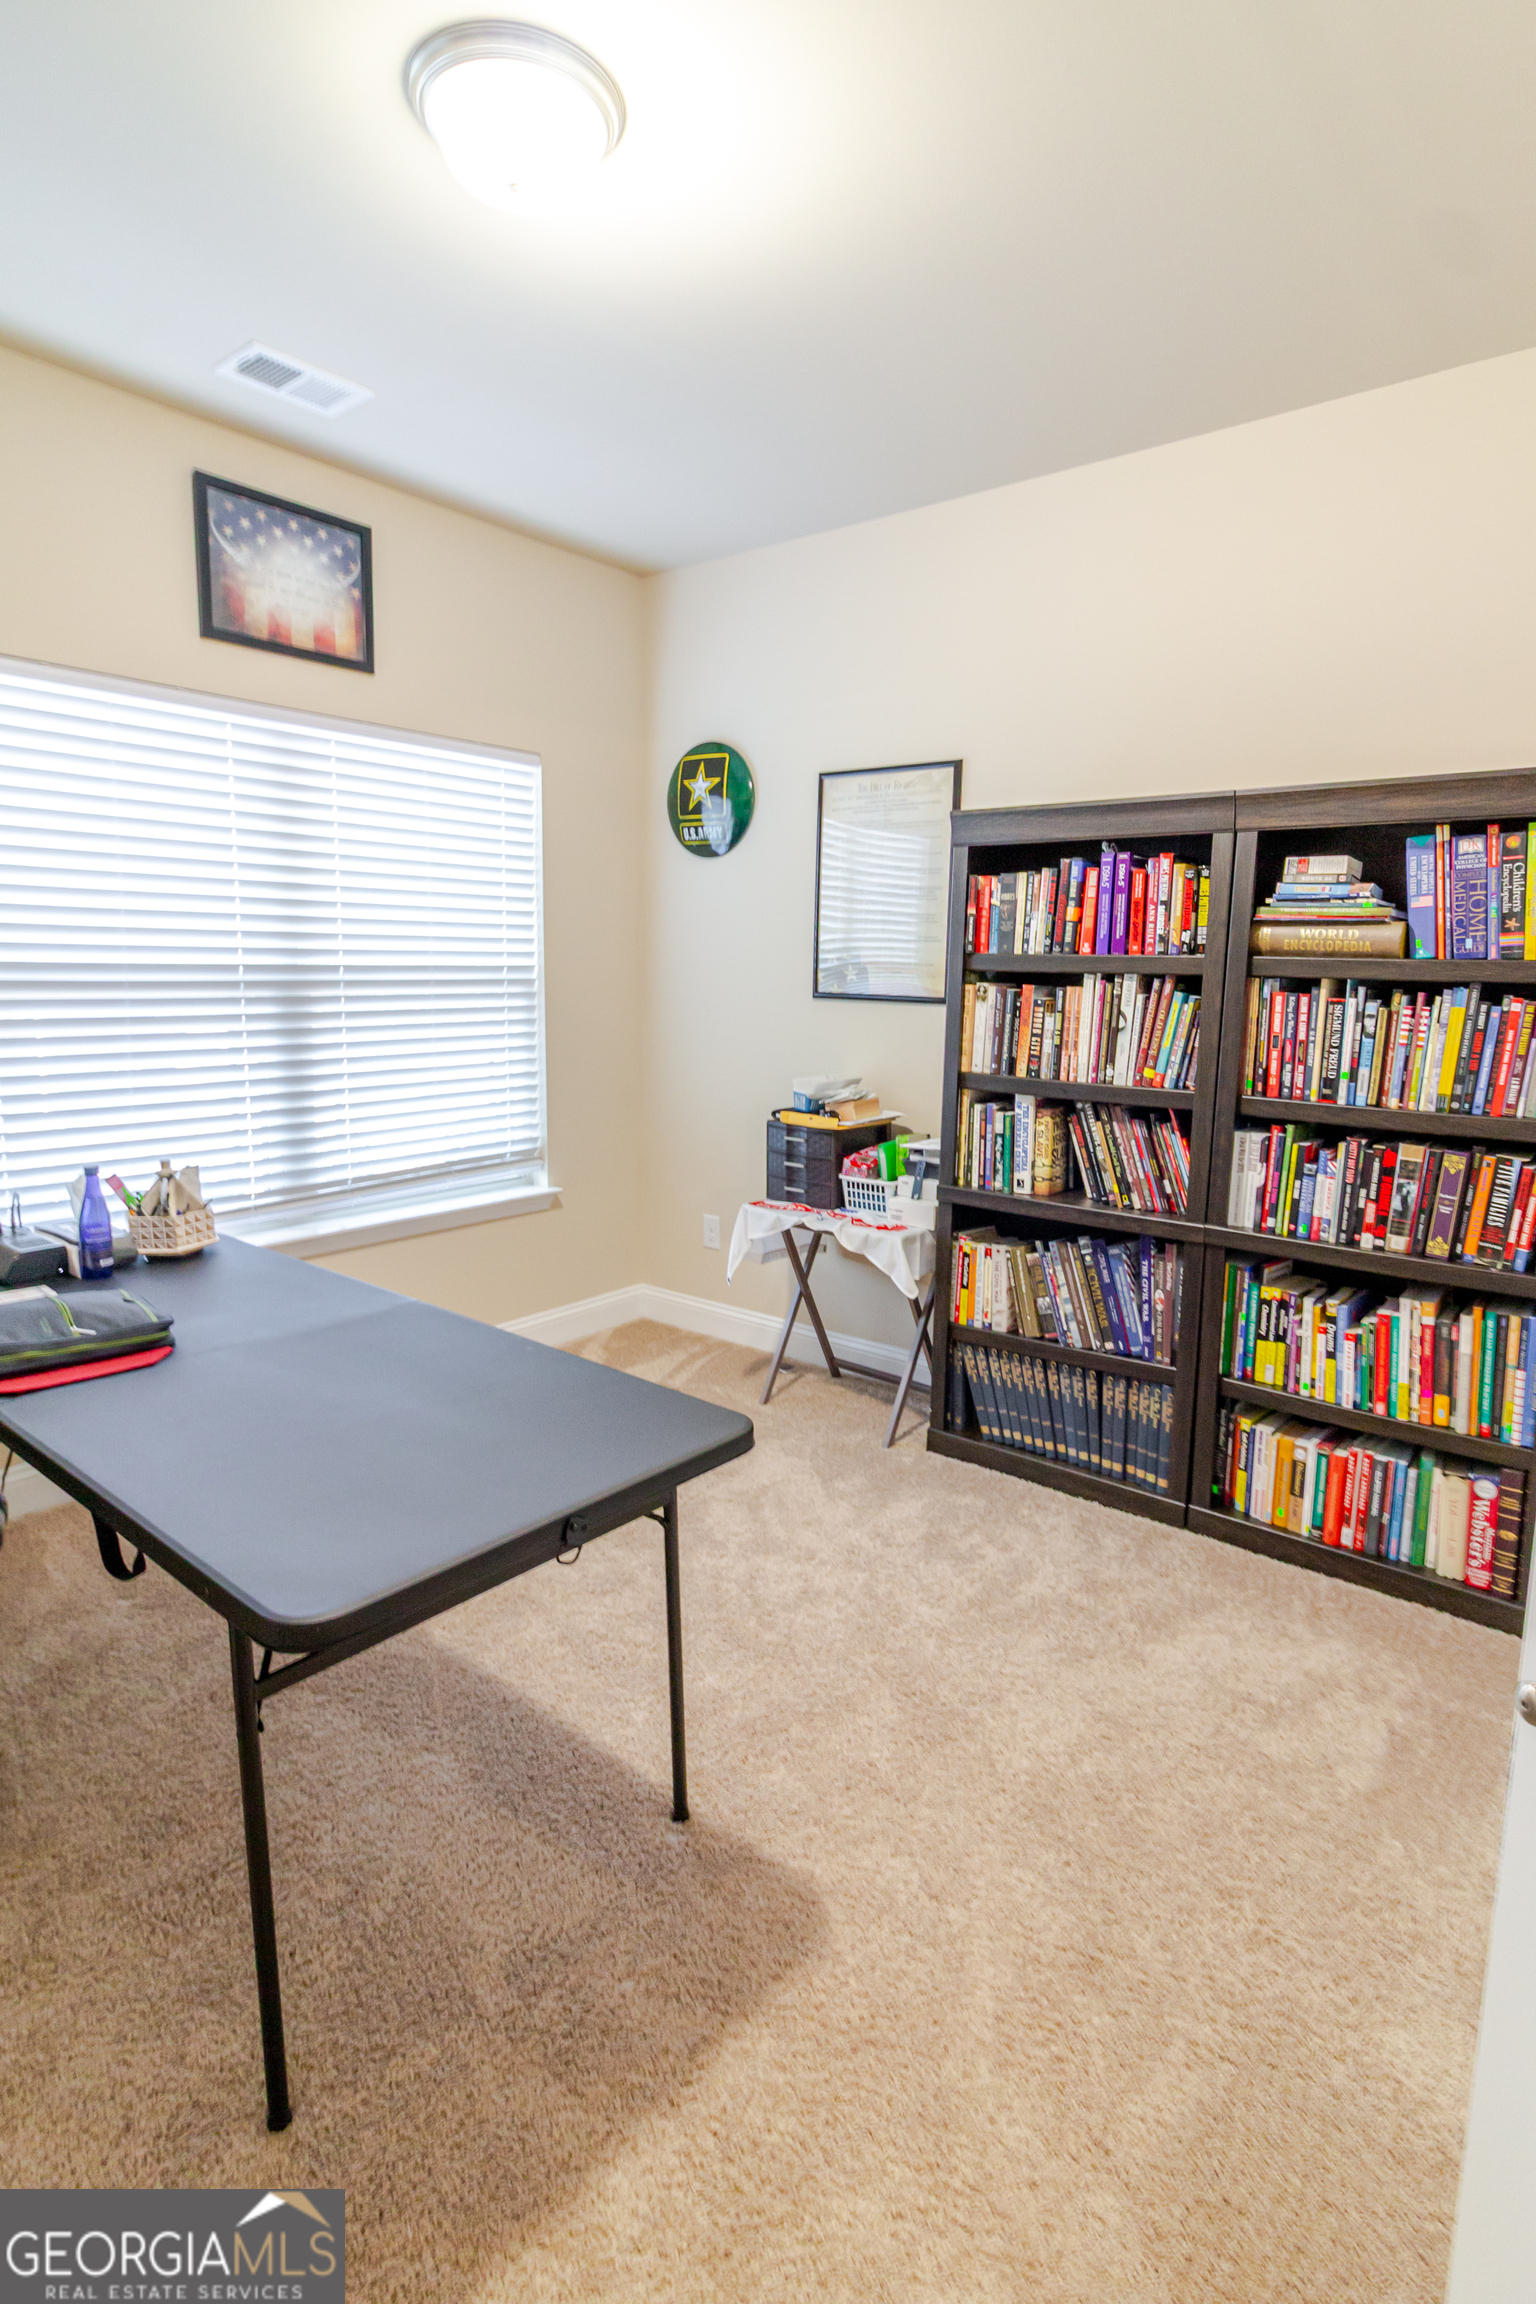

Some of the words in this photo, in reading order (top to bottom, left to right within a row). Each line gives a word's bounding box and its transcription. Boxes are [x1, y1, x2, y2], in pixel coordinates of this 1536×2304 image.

[683, 827, 698, 841] U.S.
[699, 826, 722, 840] ARMY
[1462, 839, 1481, 851] DK
[1101, 866, 1110, 888] DSM-5
[1118, 864, 1126, 888] DSM-5
[1421, 855, 1429, 894] ENCYCLOPEDIA
[1513, 862, 1525, 912] Children's
[1501, 863, 1512, 913] Encyclopedia
[1454, 881, 1466, 943] MEDICAL
[1469, 880, 1487, 942] HOME
[1283, 939, 1372, 952] ENCYCLOPEDIA
[1300, 928, 1359, 940] WORLD
[1032, 1006, 1043, 1034] DODGE
[1142, 993, 1158, 1049] GUNFIGHTERS
[1157, 1010, 1166, 1030] OLD
[1523, 1014, 1534, 1028] GREAT
[1526, 1005, 1535, 1013] THE
[1330, 1005, 1343, 1046] SIGMUND
[1464, 1020, 1472, 1036] UNITED
[1031, 1037, 1041, 1056] CITY
[1148, 1030, 1162, 1056] WEST
[1461, 1037, 1469, 1057] STATES
[1517, 1029, 1531, 1055] DEPRESSION
[1327, 1048, 1339, 1079] FREUD
[1483, 1048, 1491, 1067] American
[1480, 1067, 1488, 1088] Revolution
[1016, 1102, 1021, 1111] OF
[1021, 1121, 1029, 1172] ENCYCLOPEDIA
[1348, 1141, 1358, 1159] PRETTY
[1345, 1169, 1355, 1184] FLOYD
[1347, 1159, 1356, 1169] BOY
[1495, 1164, 1514, 1186] FIVE
[1300, 1180, 1308, 1213] HISTORY
[1306, 1181, 1314, 1213] AMERICAN
[1487, 1186, 1511, 1228] FAMILIES
[1088, 1273, 1102, 1300] CIVIL
[1095, 1303, 1108, 1328] WAR
[1259, 1304, 1269, 1337] Chemistry
[1326, 1323, 1336, 1352] Drums
[1239, 1432, 1248, 1470] Self-Publishing
[1347, 1455, 1356, 1473] BODY
[1361, 1457, 1370, 1475] BODY
[1294, 1462, 1304, 1498] Dictionary
[1343, 1475, 1353, 1509] LANGUAGE
[1358, 1477, 1368, 1510] LANGUAGE
[1468, 1499, 1490, 1568] Webster's
